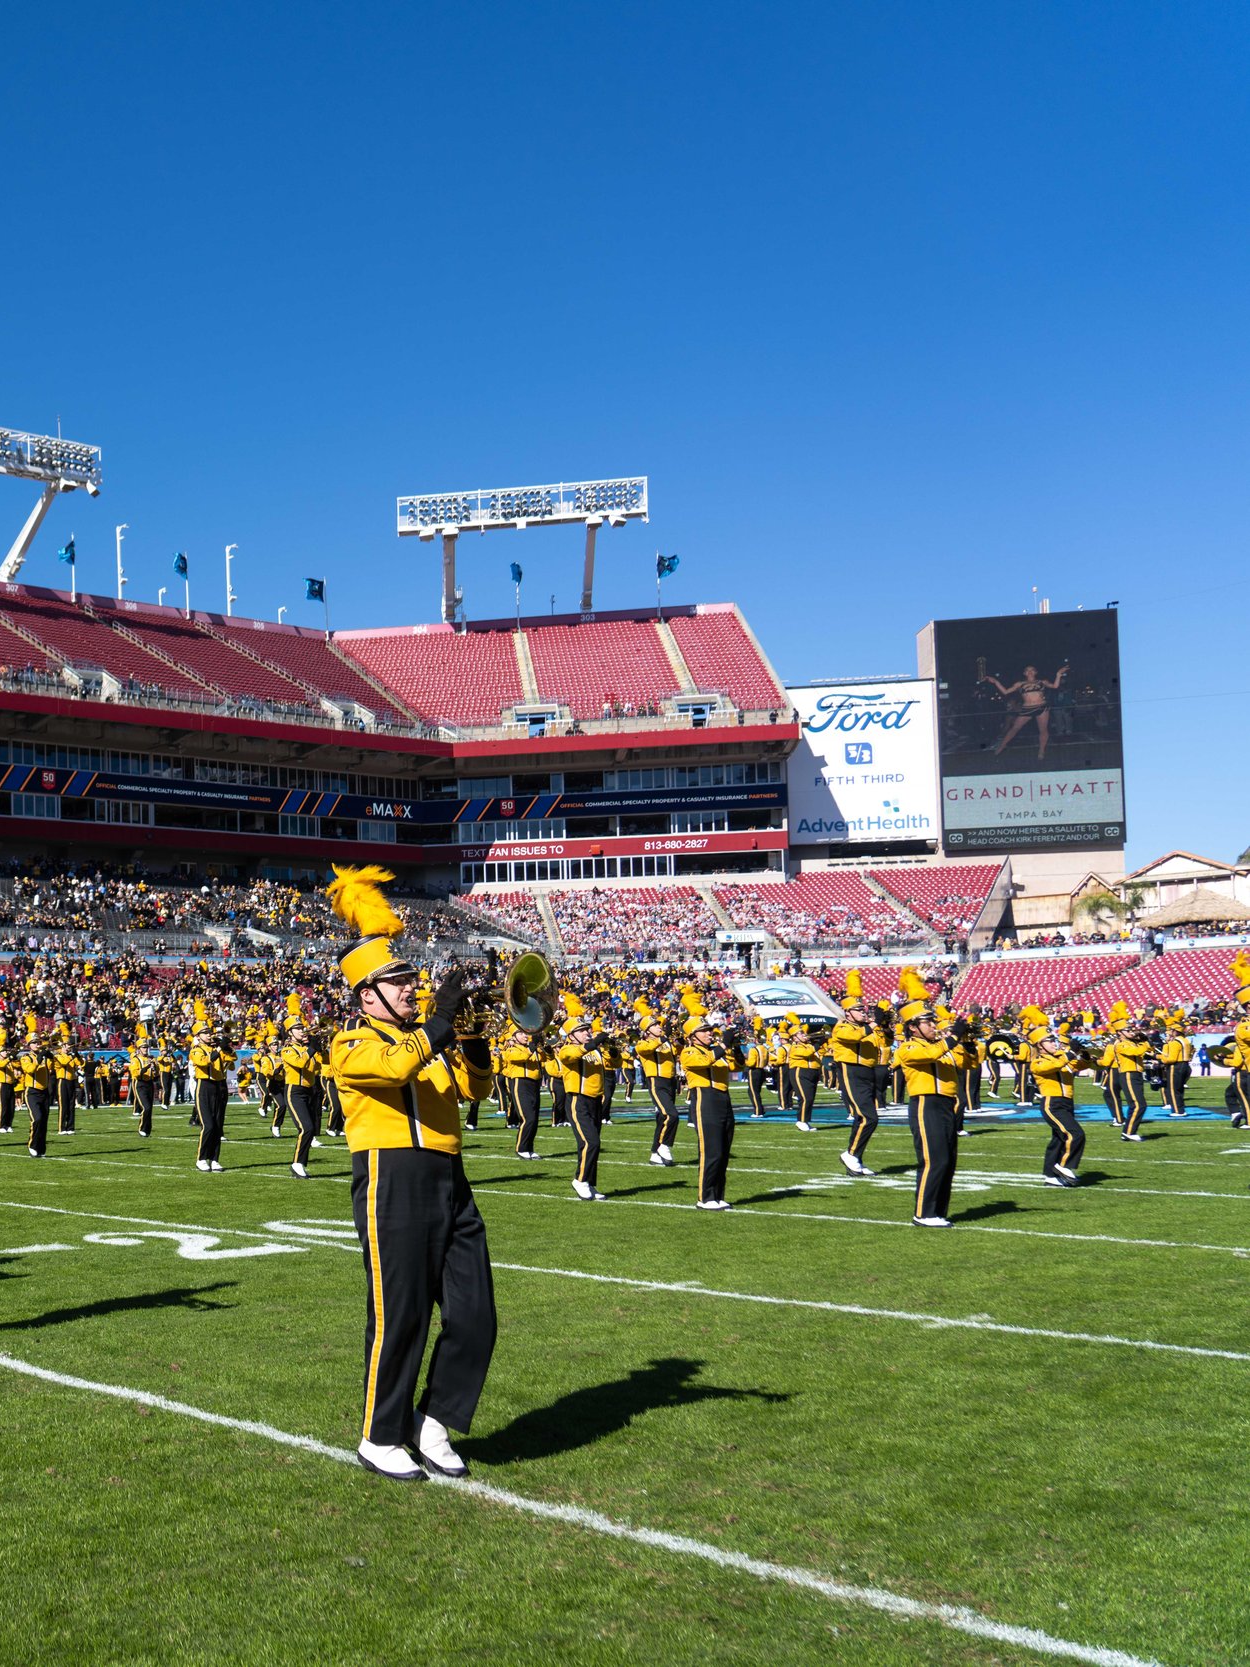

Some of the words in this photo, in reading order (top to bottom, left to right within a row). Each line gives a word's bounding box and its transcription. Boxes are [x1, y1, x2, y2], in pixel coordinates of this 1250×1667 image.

[6, 584, 19, 592] 307
[581, 614, 596, 622] 303
[807, 693, 913, 733] Ford
[42, 772, 54, 782] 50
[814, 776, 855, 786] FIFTH
[861, 773, 905, 784] THIRD
[117, 784, 148, 792] COMMERCIAL
[173, 789, 196, 797] PROPERTY
[201, 791, 223, 799] CASUALTY
[224, 793, 248, 801] INSURANCE
[946, 785, 1023, 801] GRAND
[1039, 781, 1115, 796] HYATT
[365, 802, 412, 818] eMAXX
[501, 801, 514, 810] 50
[998, 811, 1037, 820] TAMPA
[1042, 809, 1063, 818] BAY
[797, 814, 930, 833] AdventHealth
[1105, 828, 1119, 836] CC
[949, 834, 963, 842] CC
[644, 839, 708, 850] 813-680-2827
[461, 848, 486, 858] TEXT
[489, 847, 509, 857] FAN
[511, 846, 547, 856] ISSUES
[549, 845, 564, 854] TO
